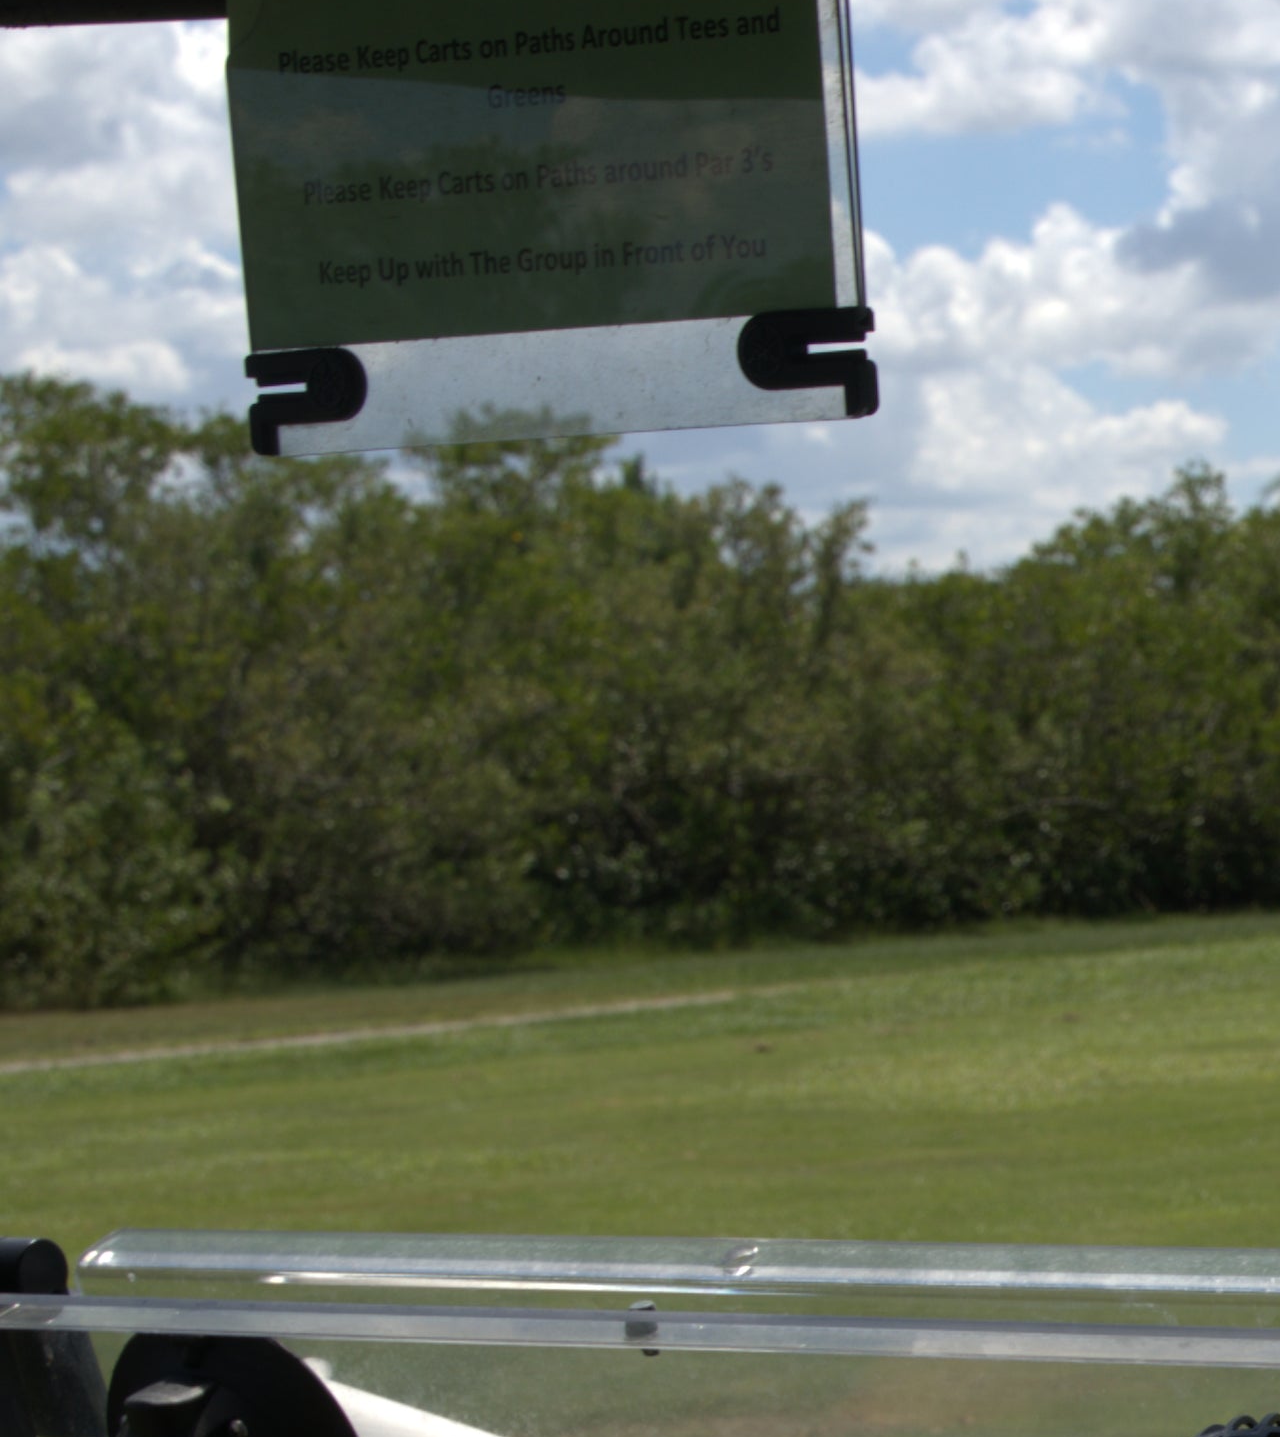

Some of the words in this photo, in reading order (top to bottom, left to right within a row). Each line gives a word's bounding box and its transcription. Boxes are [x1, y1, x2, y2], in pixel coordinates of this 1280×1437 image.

[279, 50, 351, 75] Please
[356, 45, 409, 71] Keep
[415, 38, 473, 64] Carts
[479, 38, 508, 59] on
[515, 27, 575, 55] Paths
[581, 17, 669, 49] Around
[675, 16, 729, 40] Tees
[736, 5, 780, 35] and
[488, 84, 566, 109] Greens
[304, 179, 372, 205] Please
[379, 175, 431, 202] Keep
[438, 170, 496, 195] Carts
[502, 170, 529, 191] on
[536, 163, 597, 188] Paths
[605, 155, 688, 184] around
[694, 151, 734, 177] Par
[319, 260, 371, 288] Keep
[378, 258, 409, 286] Up
[415, 253, 464, 279] with
[470, 250, 511, 275] The
[517, 247, 587, 275] Group
[594, 243, 615, 267] in
[622, 240, 684, 266] Front
[690, 235, 716, 261] of
[720, 234, 766, 259] You
